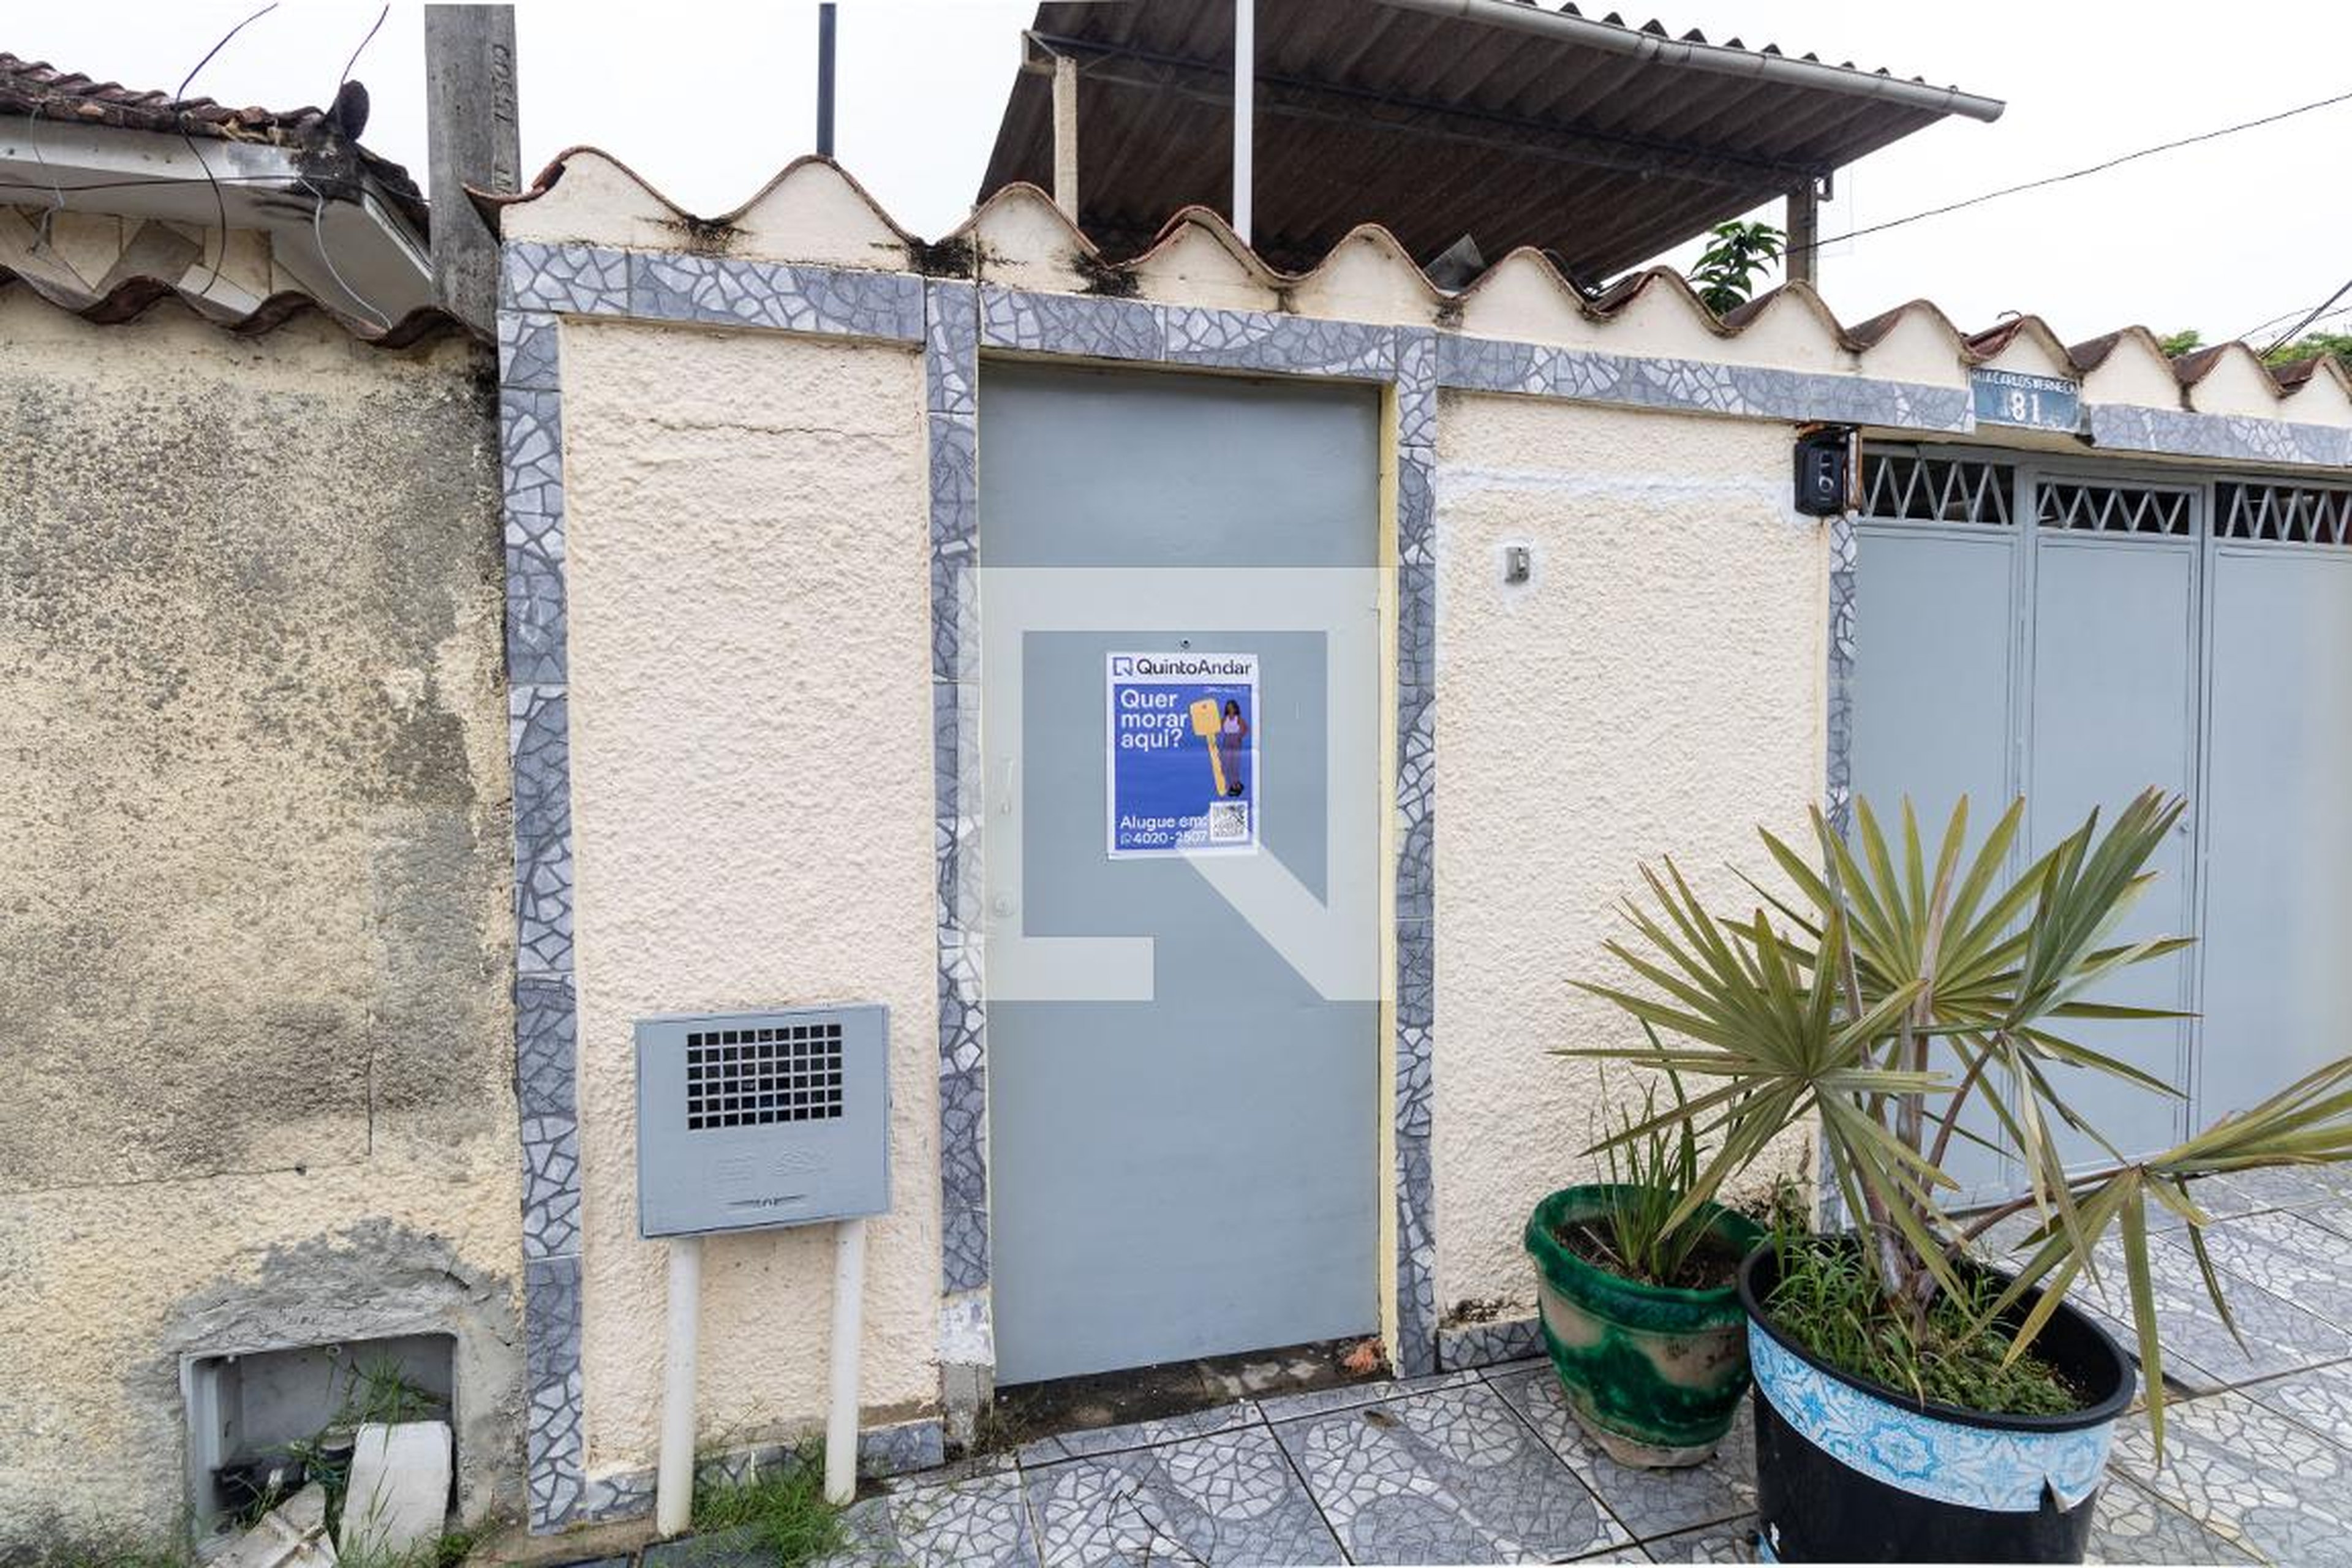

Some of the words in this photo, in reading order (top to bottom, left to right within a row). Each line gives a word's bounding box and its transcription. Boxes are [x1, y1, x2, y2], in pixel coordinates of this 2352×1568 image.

[2011, 390, 2041, 424] 81
[1136, 658, 1252, 676] QuintoAndar
[1120, 690, 1178, 707] Quer
[1121, 712, 1188, 728] morar
[1120, 728, 1183, 752] aqui?
[1120, 815, 1175, 831] Alugue
